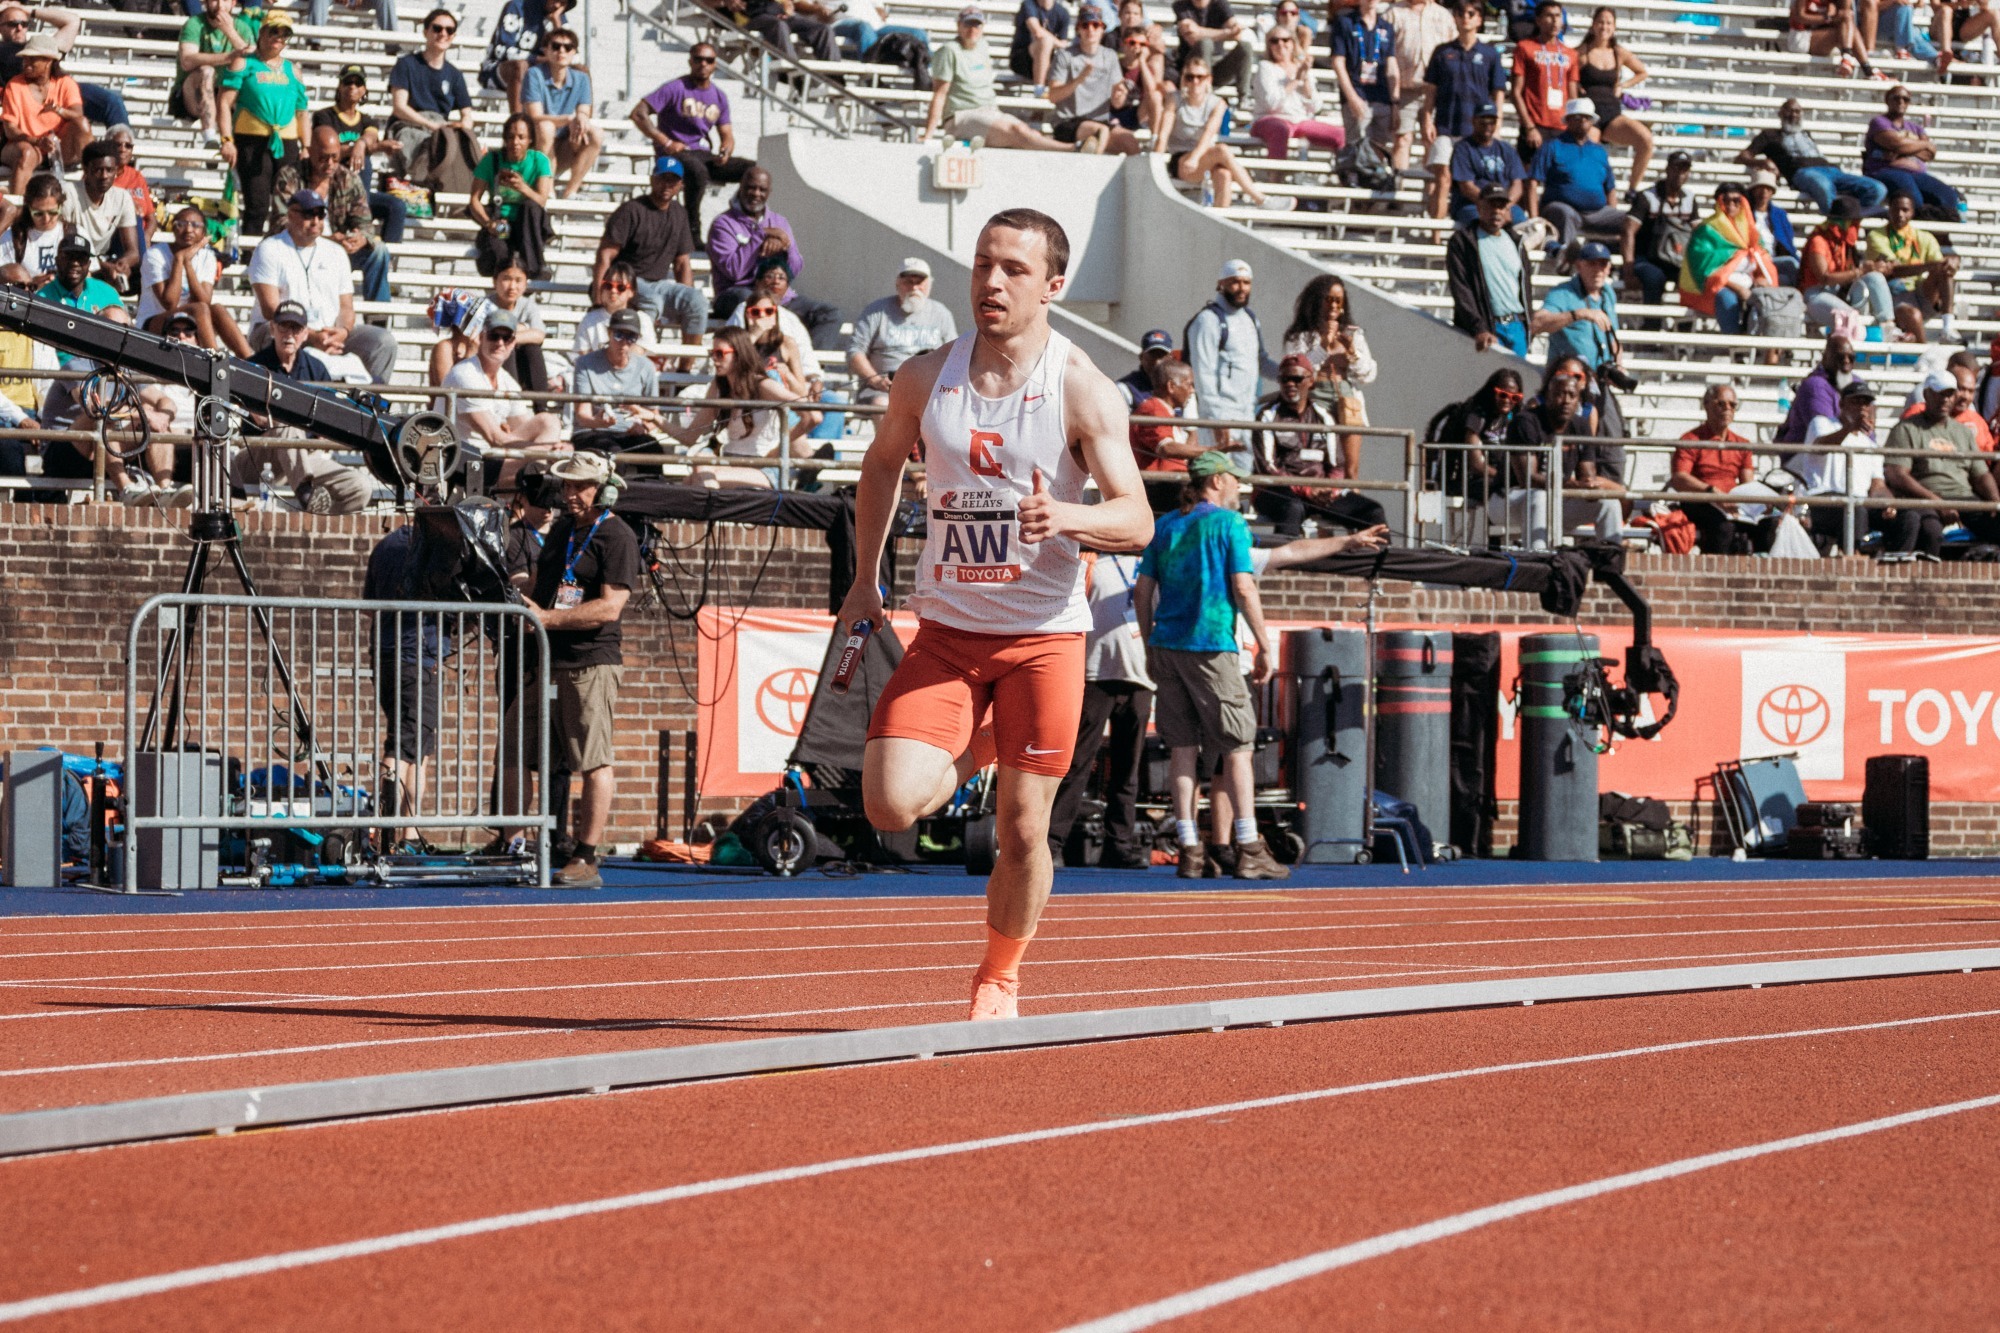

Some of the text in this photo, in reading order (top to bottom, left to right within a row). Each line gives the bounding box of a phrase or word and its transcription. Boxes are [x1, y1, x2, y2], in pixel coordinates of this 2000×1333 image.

[946, 157, 977, 184] EXIT
[939, 384, 953, 395] Ivy
[969, 429, 1006, 479] C
[961, 500, 1003, 508] RELAYS
[962, 491, 992, 500] PENN
[944, 512, 976, 520] Dream On.
[941, 523, 1010, 564] AW
[959, 568, 1014, 580] TOYOTA
[837, 649, 855, 676] TOYOTA
[1868, 688, 2000, 746] TOY
